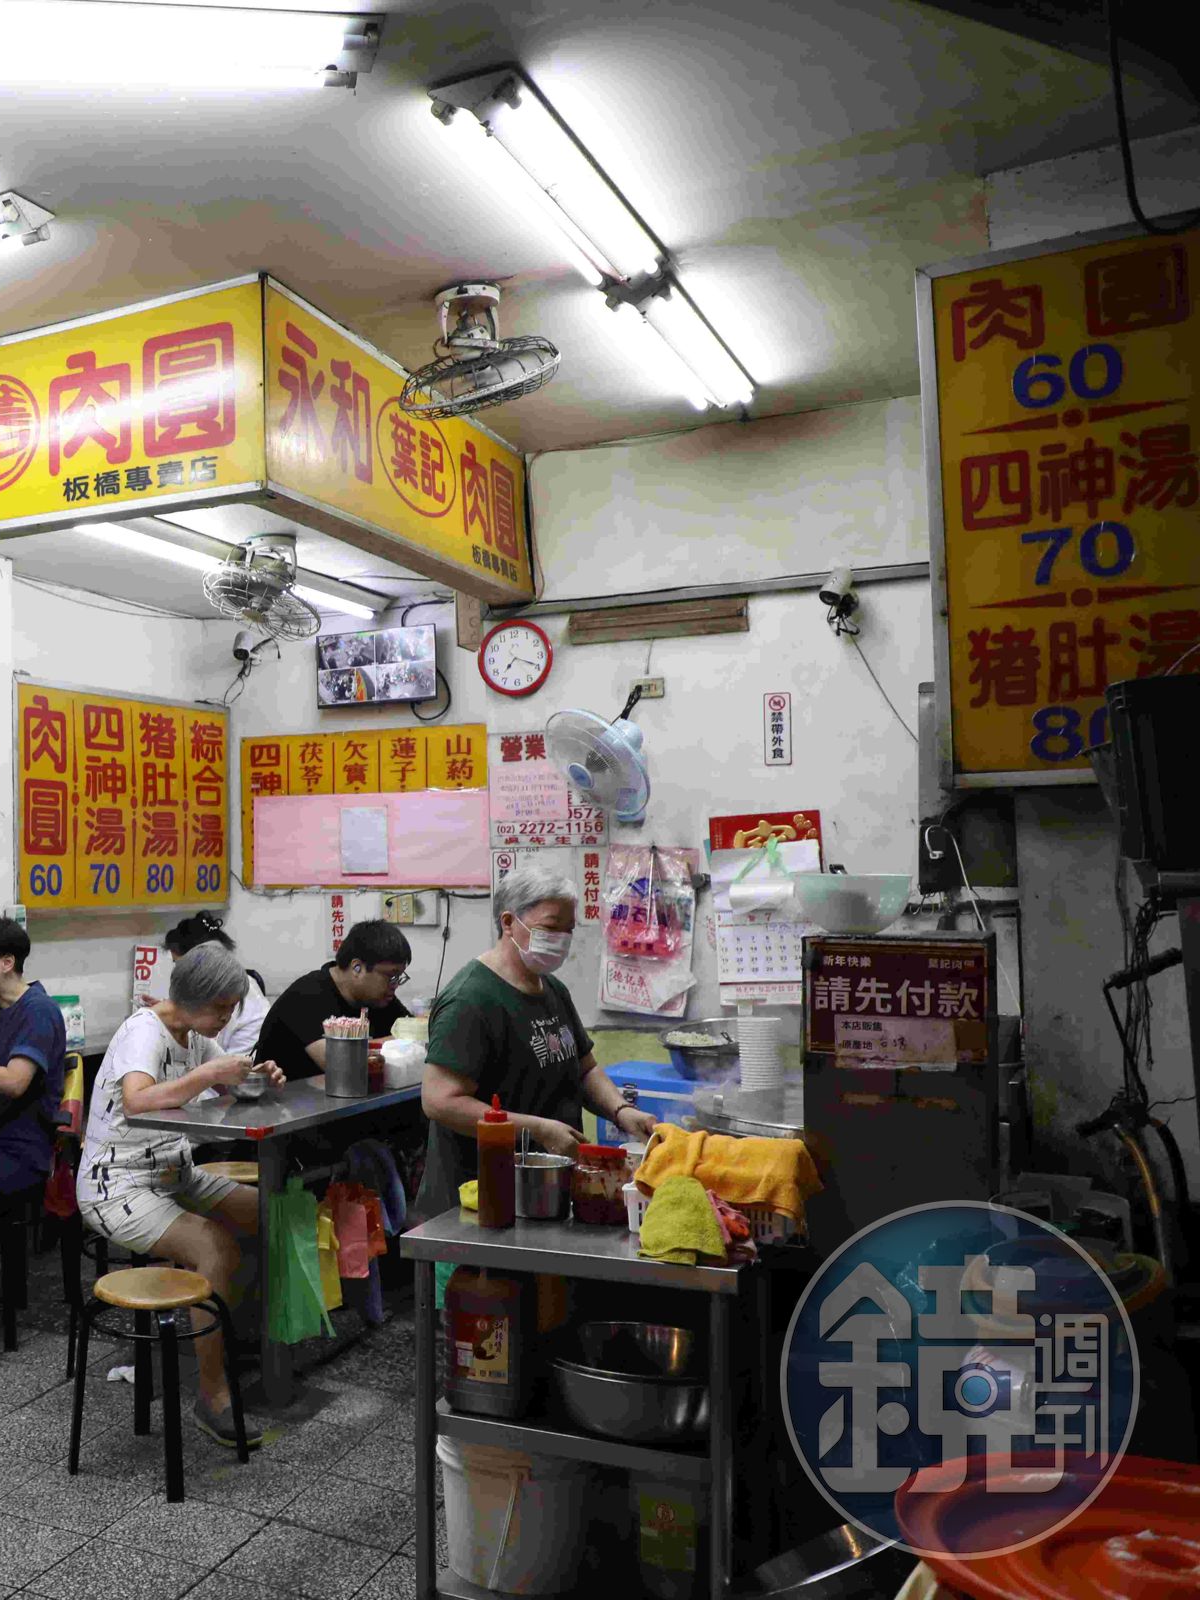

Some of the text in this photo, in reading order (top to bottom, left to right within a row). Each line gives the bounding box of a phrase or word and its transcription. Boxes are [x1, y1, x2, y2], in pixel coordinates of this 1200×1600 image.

[952, 243, 1190, 361] 肉圓
[1012, 343, 1123, 408] 60
[278, 321, 519, 560] 永和葉記肉圓
[63, 456, 219, 502] 板橋專賣店
[961, 424, 1200, 530] 四神湯
[1021, 521, 1136, 585] 70
[510, 630, 518, 639] 12
[501, 734, 546, 762] 營業
[771, 712, 784, 758] 禁帶外食
[24, 695, 68, 855] 肉圓
[83, 704, 126, 856] 四神湯
[390, 737, 416, 783] 蓮子
[190, 720, 224, 857] 綜合湯
[497, 822, 604, 835] (02) 2272-1156
[30, 864, 62, 895] 60
[90, 864, 120, 894] 70
[146, 864, 174, 892] 80
[196, 864, 221, 892] 80
[584, 853, 600, 920] 請先付款
[814, 975, 980, 1018] 請先付款
